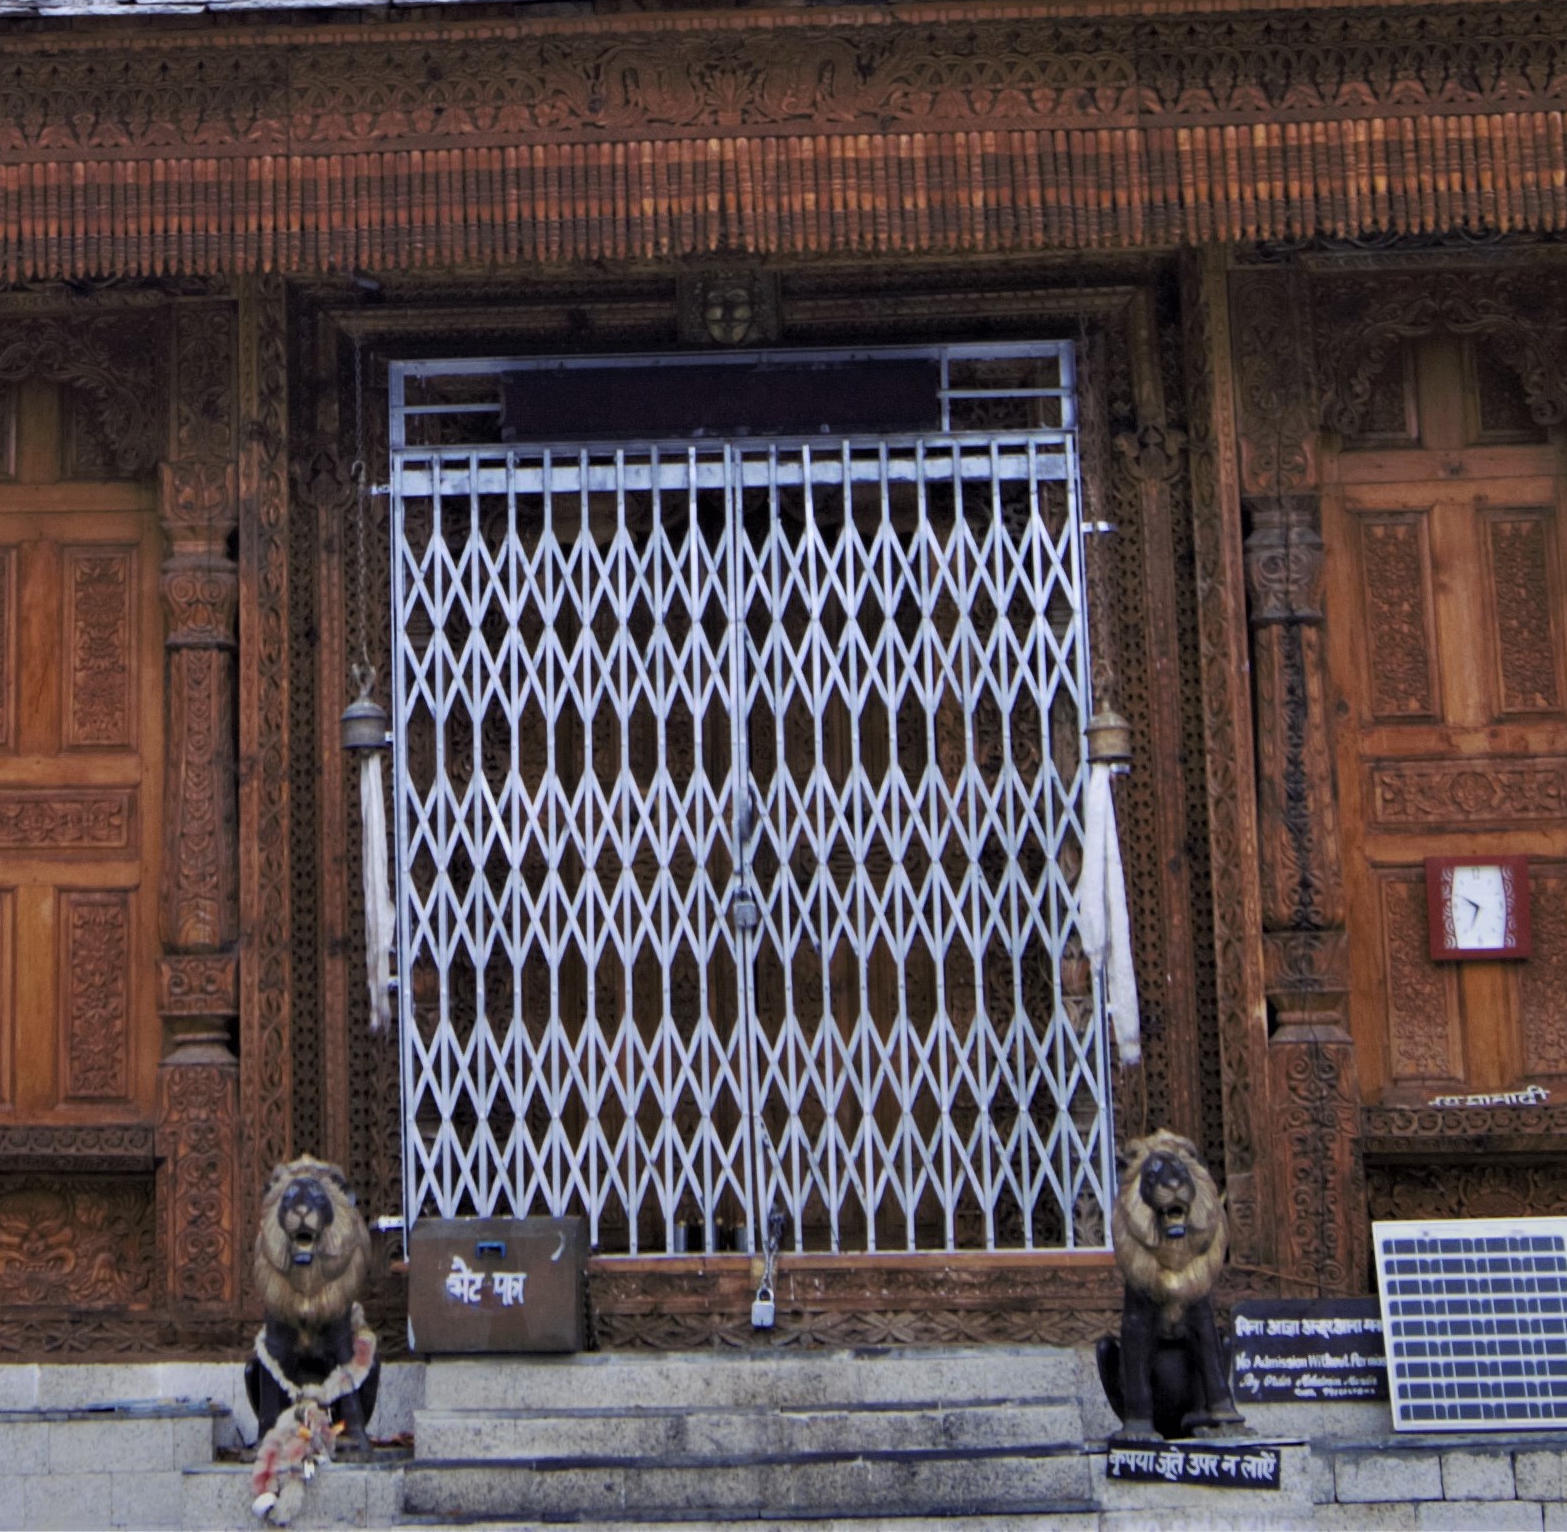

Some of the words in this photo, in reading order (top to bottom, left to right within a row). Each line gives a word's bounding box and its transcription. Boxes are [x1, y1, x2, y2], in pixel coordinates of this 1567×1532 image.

[1235, 1315, 1264, 1336] बिना
[1235, 1351, 1252, 1371] No
[1109, 1449, 1156, 1476] कृपया
[1155, 1446, 1185, 1481] जूते
[1186, 1453, 1220, 1477] उपर
[1221, 1455, 1240, 1477] न
